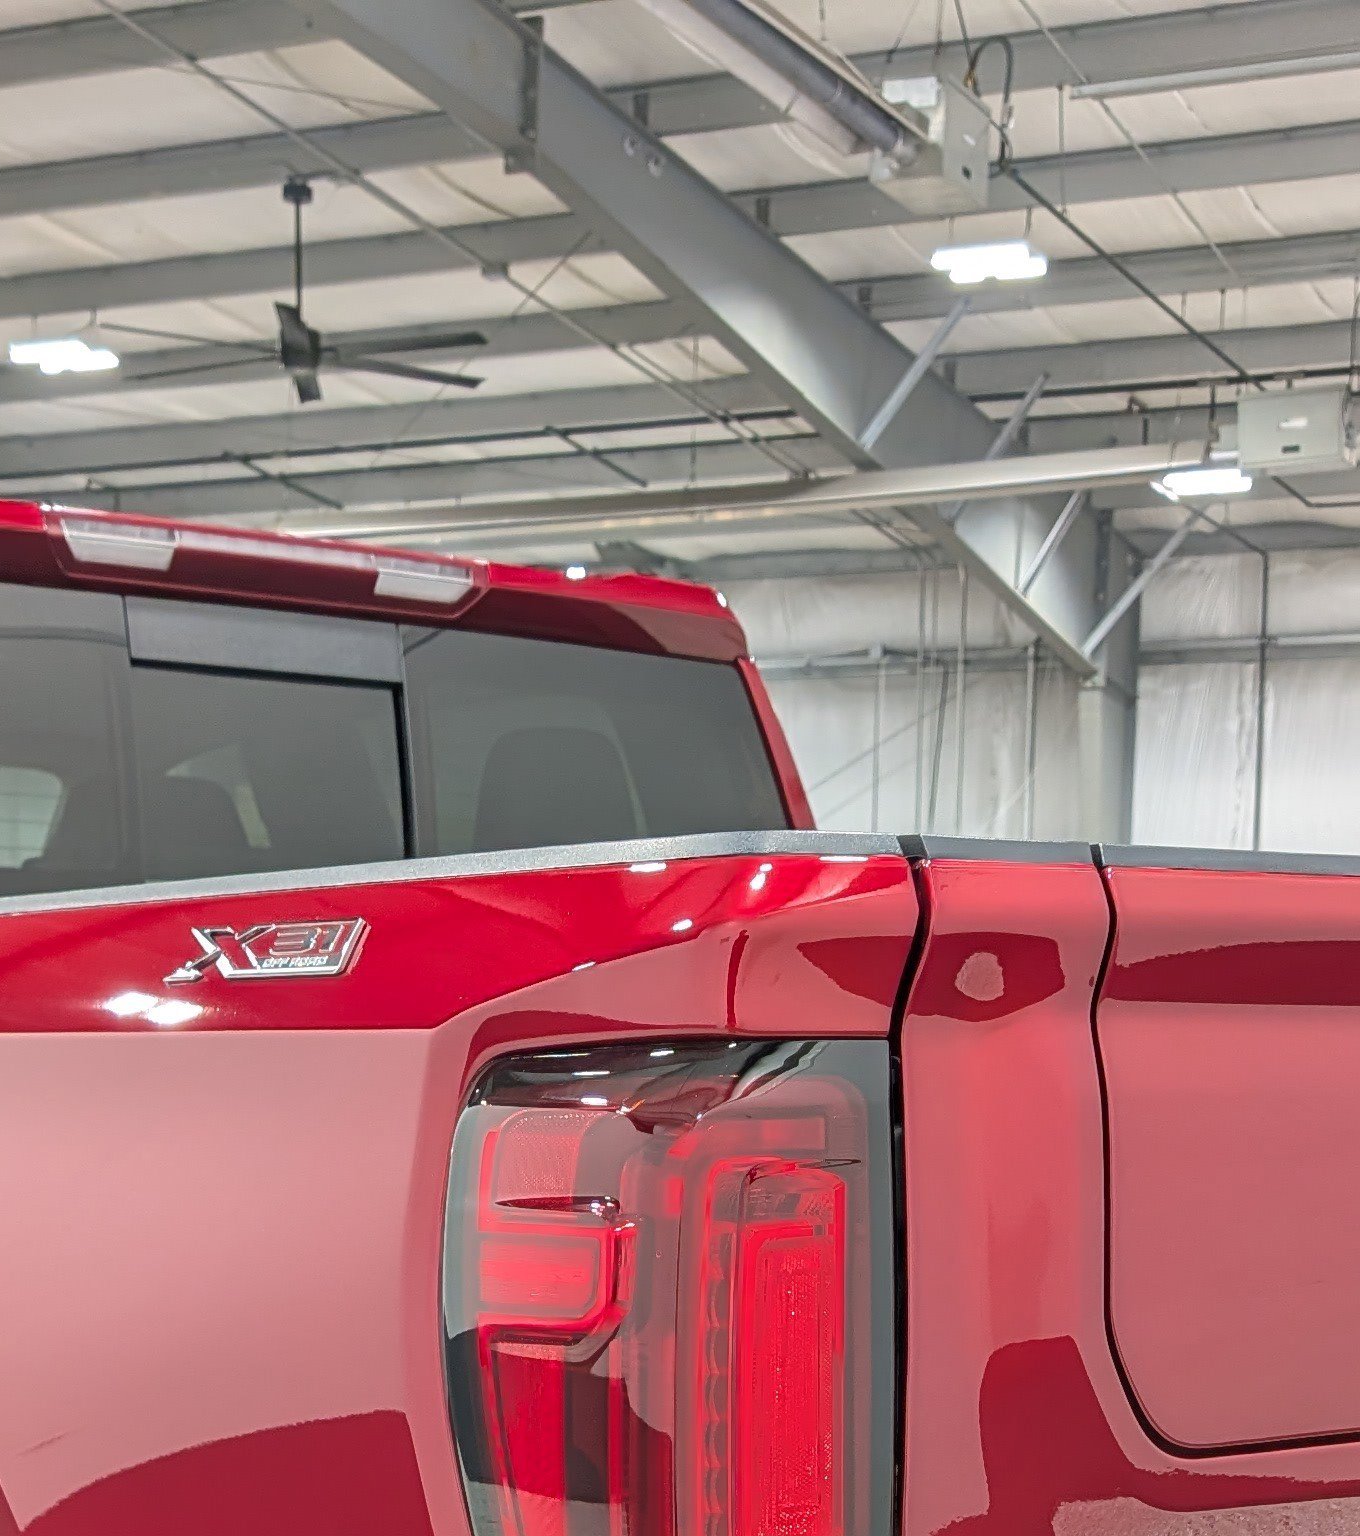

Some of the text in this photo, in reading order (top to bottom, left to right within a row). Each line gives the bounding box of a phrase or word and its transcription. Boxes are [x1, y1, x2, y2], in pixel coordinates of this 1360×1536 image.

[165, 918, 355, 986] X31
[262, 955, 329, 968] OFF ROAD
